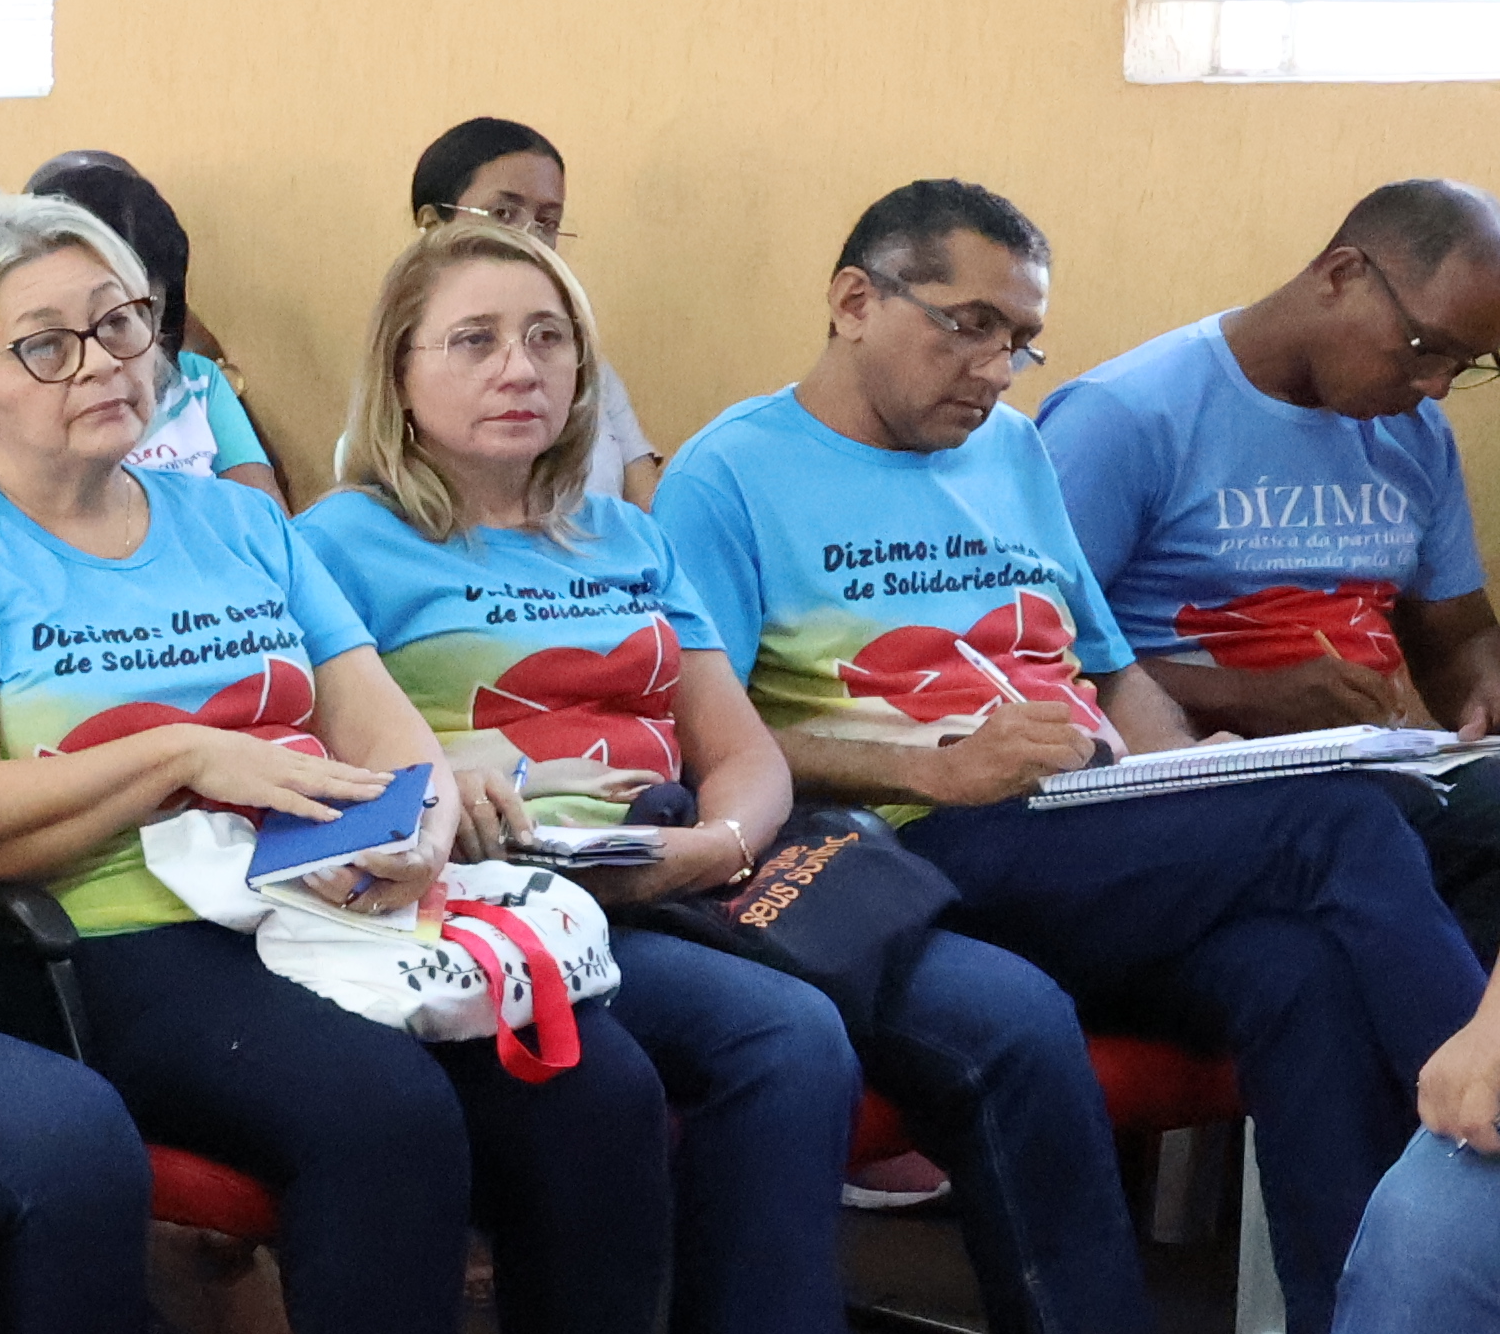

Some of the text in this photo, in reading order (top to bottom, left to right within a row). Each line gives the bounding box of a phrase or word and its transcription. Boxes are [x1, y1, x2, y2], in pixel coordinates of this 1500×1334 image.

[1216, 475, 1409, 530] DÍZIMO
[945, 534, 988, 559] Um
[1306, 532, 1331, 549] da
[843, 562, 1057, 601] de Solidariedade
[171, 609, 221, 635] Um
[486, 604, 518, 625] de
[54, 628, 302, 676] de Solidariedade
[739, 882, 799, 929] seus
